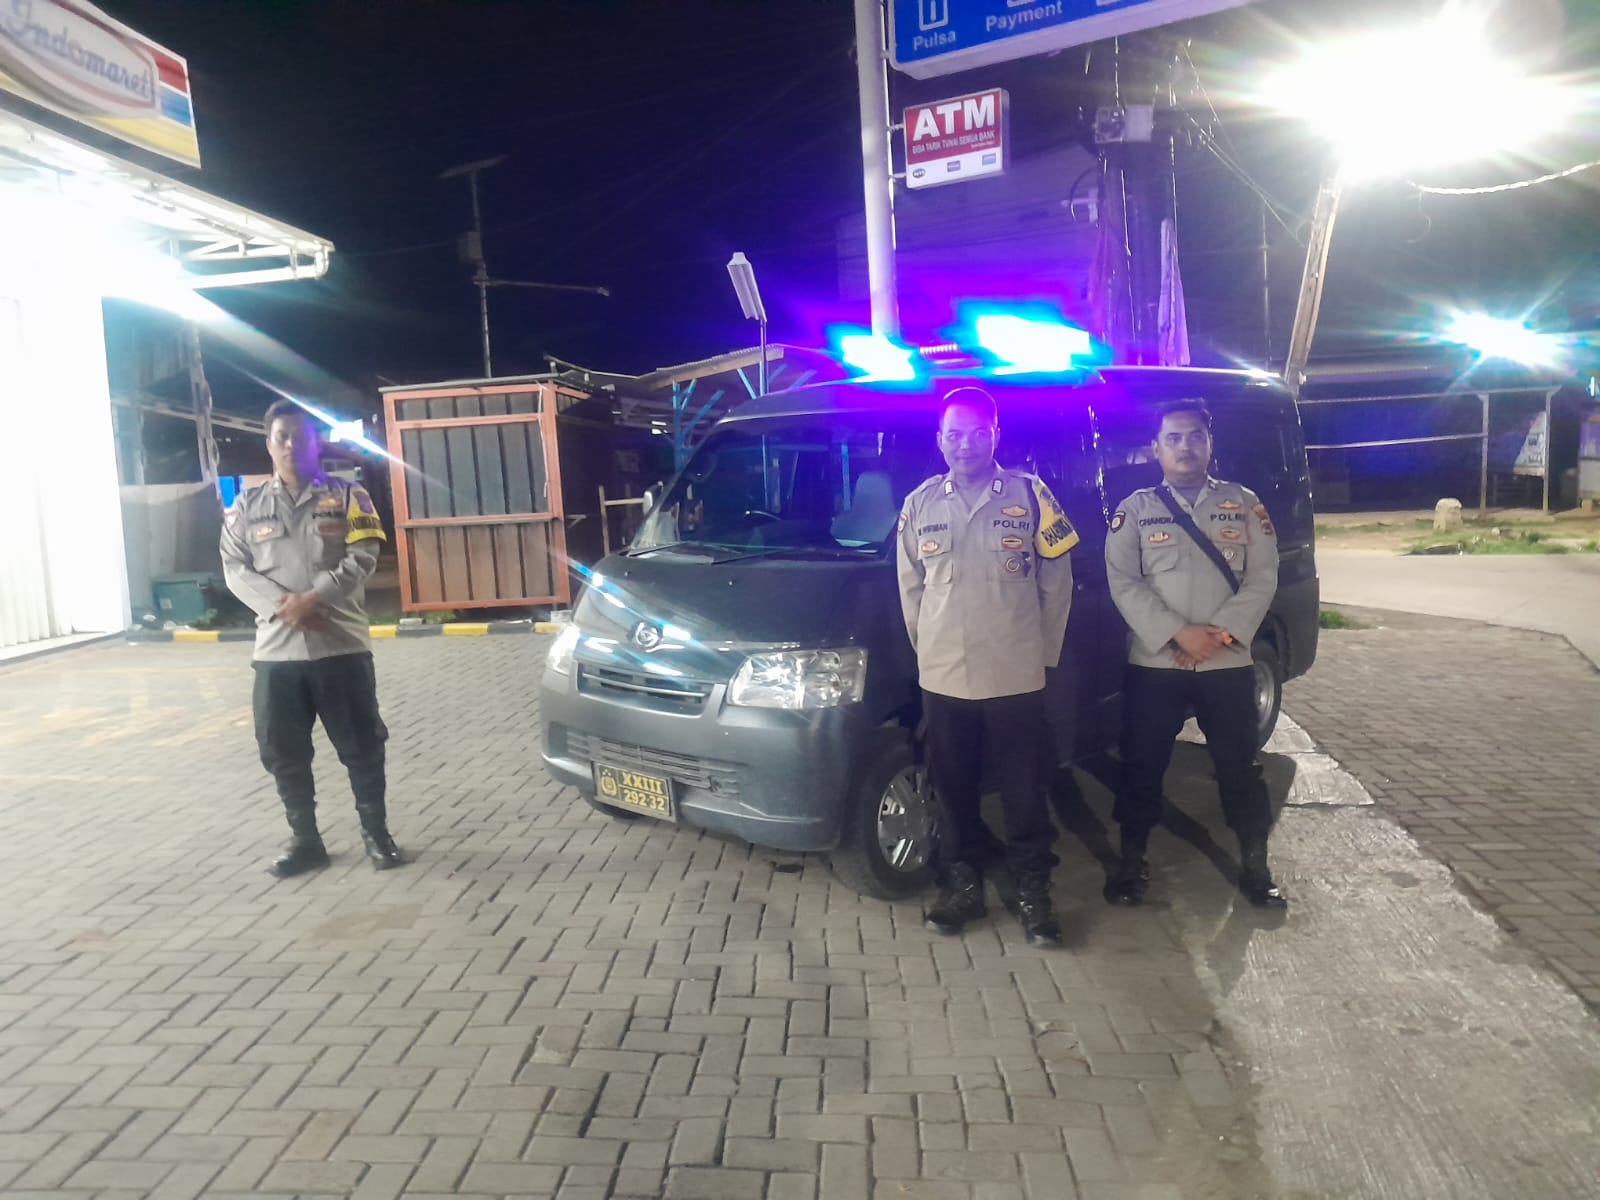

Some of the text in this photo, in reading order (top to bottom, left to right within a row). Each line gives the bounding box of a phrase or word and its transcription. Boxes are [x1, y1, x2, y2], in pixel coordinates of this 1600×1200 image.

[5, 0, 150, 98] Indomaret
[913, 1, 1063, 51] Pulsa Payment
[912, 94, 995, 142] ATM
[992, 519, 1030, 531] POLRI
[622, 771, 663, 794] XXIII
